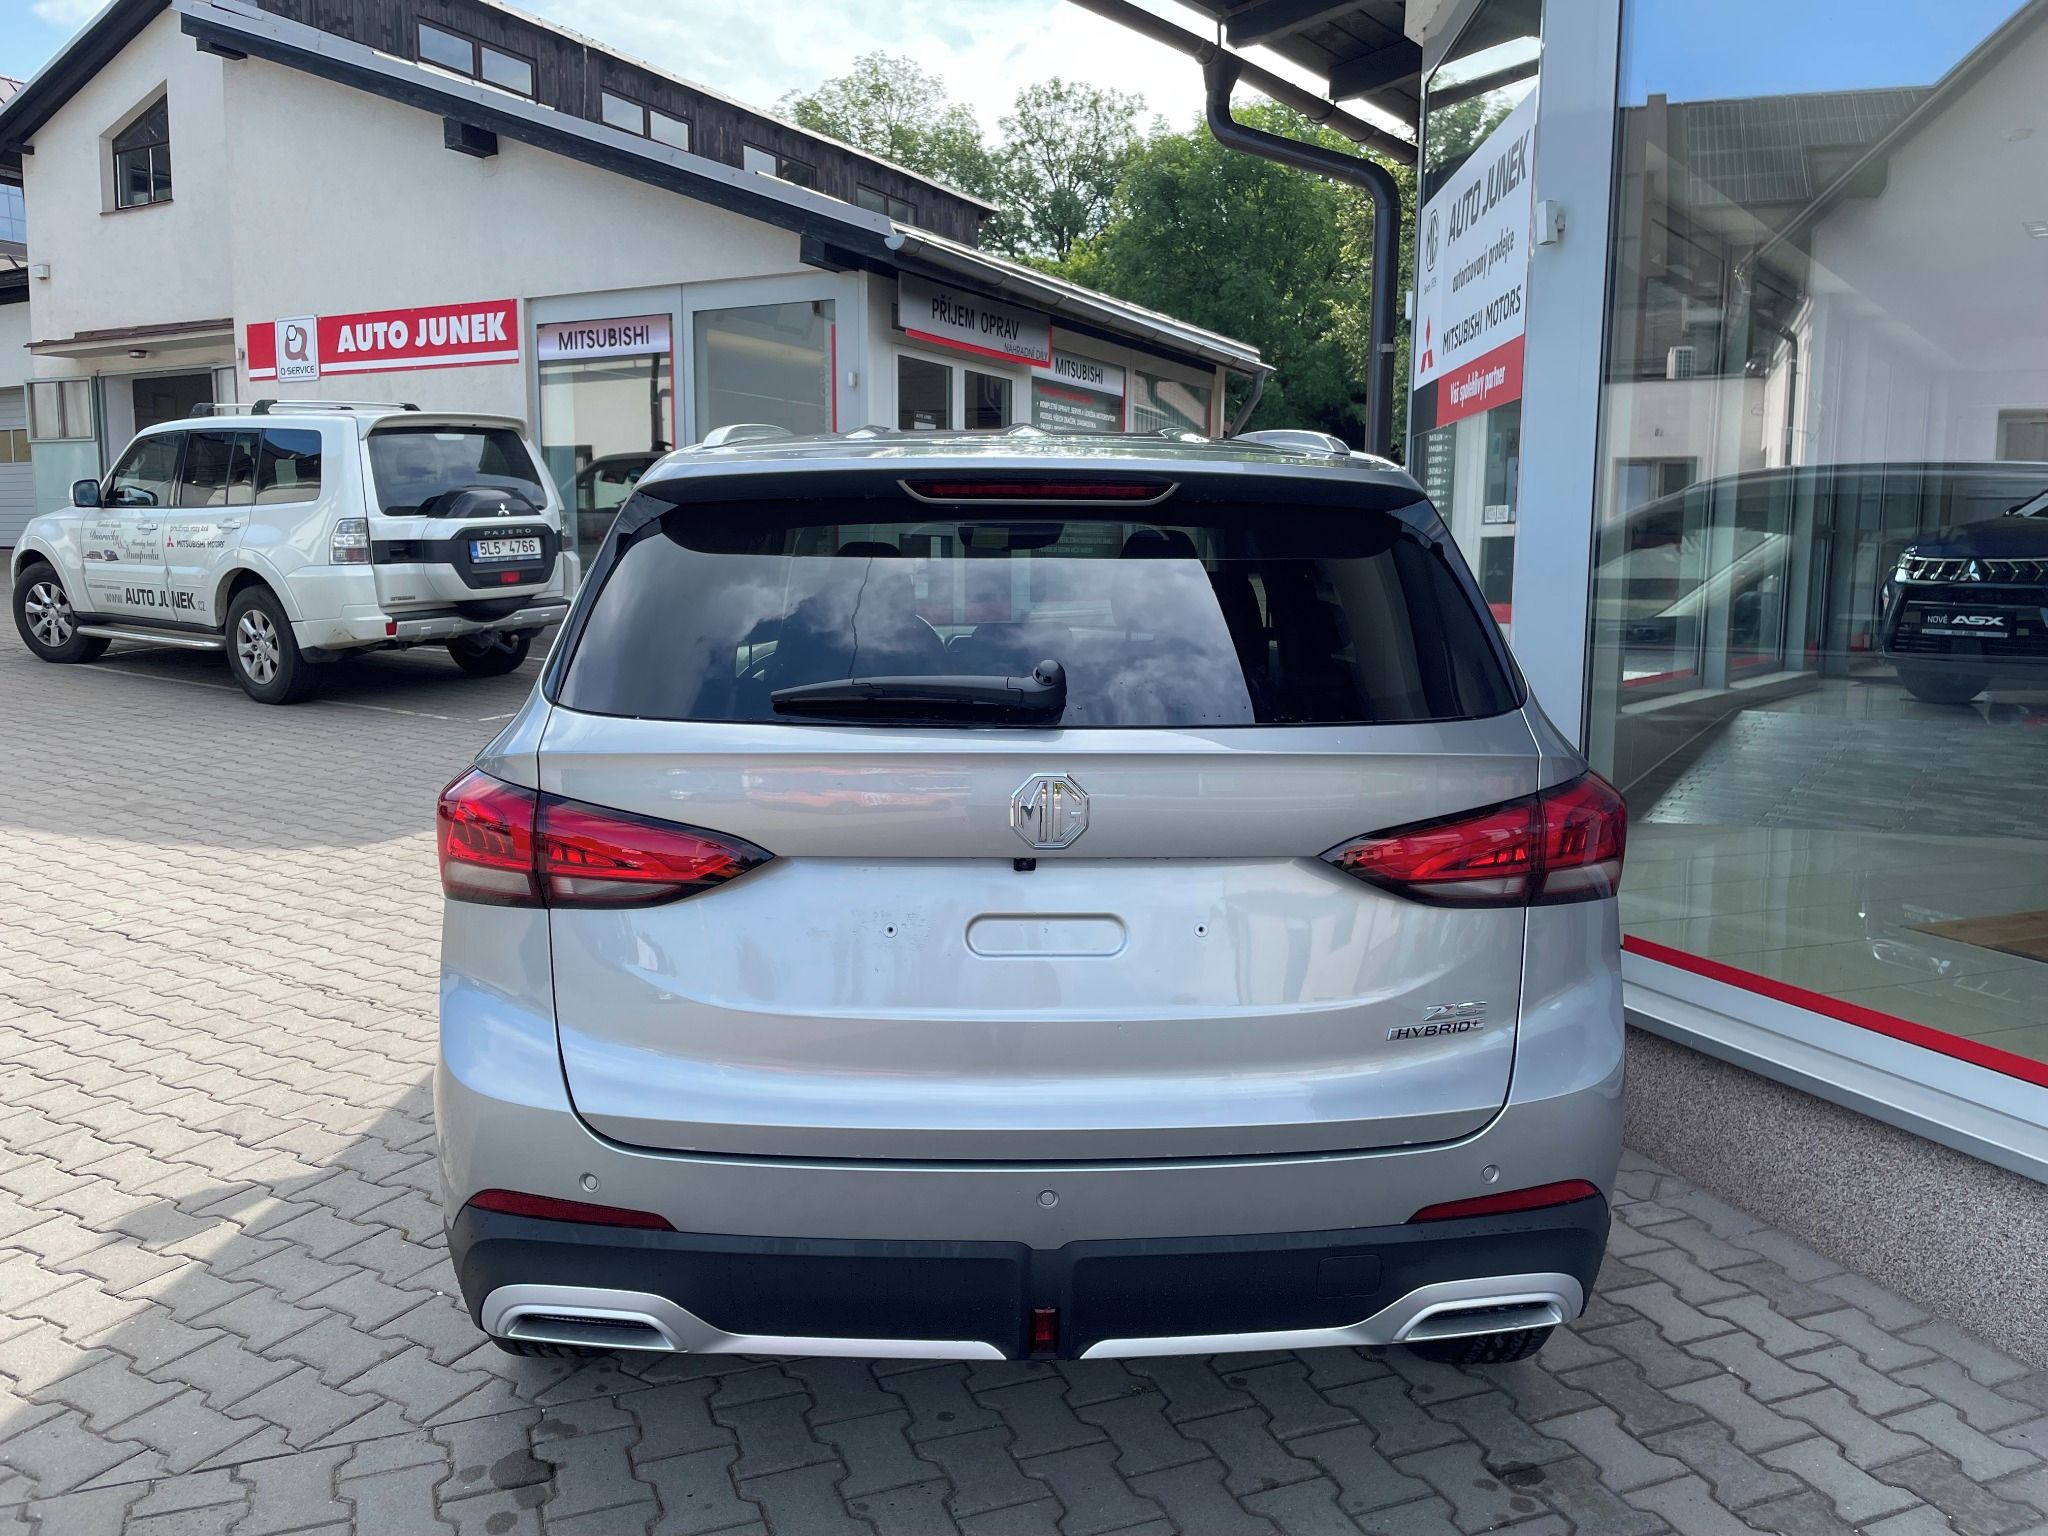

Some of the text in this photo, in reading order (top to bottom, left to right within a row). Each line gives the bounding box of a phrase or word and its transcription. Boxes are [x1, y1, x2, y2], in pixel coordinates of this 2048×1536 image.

[1448, 128, 1530, 247] AUTO JUNEK
[1426, 209, 1439, 272] MG
[1452, 226, 1514, 293] autorizovaný prodejce
[932, 293, 1019, 341] PŘÍJEM OPRAV
[1442, 309, 1482, 356] MITSUBISHI
[1486, 284, 1521, 331] MOTORS
[337, 312, 507, 353] AUTO JUNEK
[558, 325, 649, 351] MITSUBISHI
[1004, 342, 1035, 360] NÁHRADNÍ
[1055, 357, 1104, 385] MITSUBISHI
[1450, 365, 1506, 408] Váš spolehlivý partner
[176, 540, 225, 548] MITSUBISHI MOTORS
[484, 528, 532, 536] PAJERO
[480, 540, 536, 556] 5L5 4766
[125, 588, 155, 607] AUTO
[1927, 614, 2004, 626] NOVÉ ASX
[1016, 779, 1083, 844] MG
[1423, 1000, 1487, 1021] ZS
